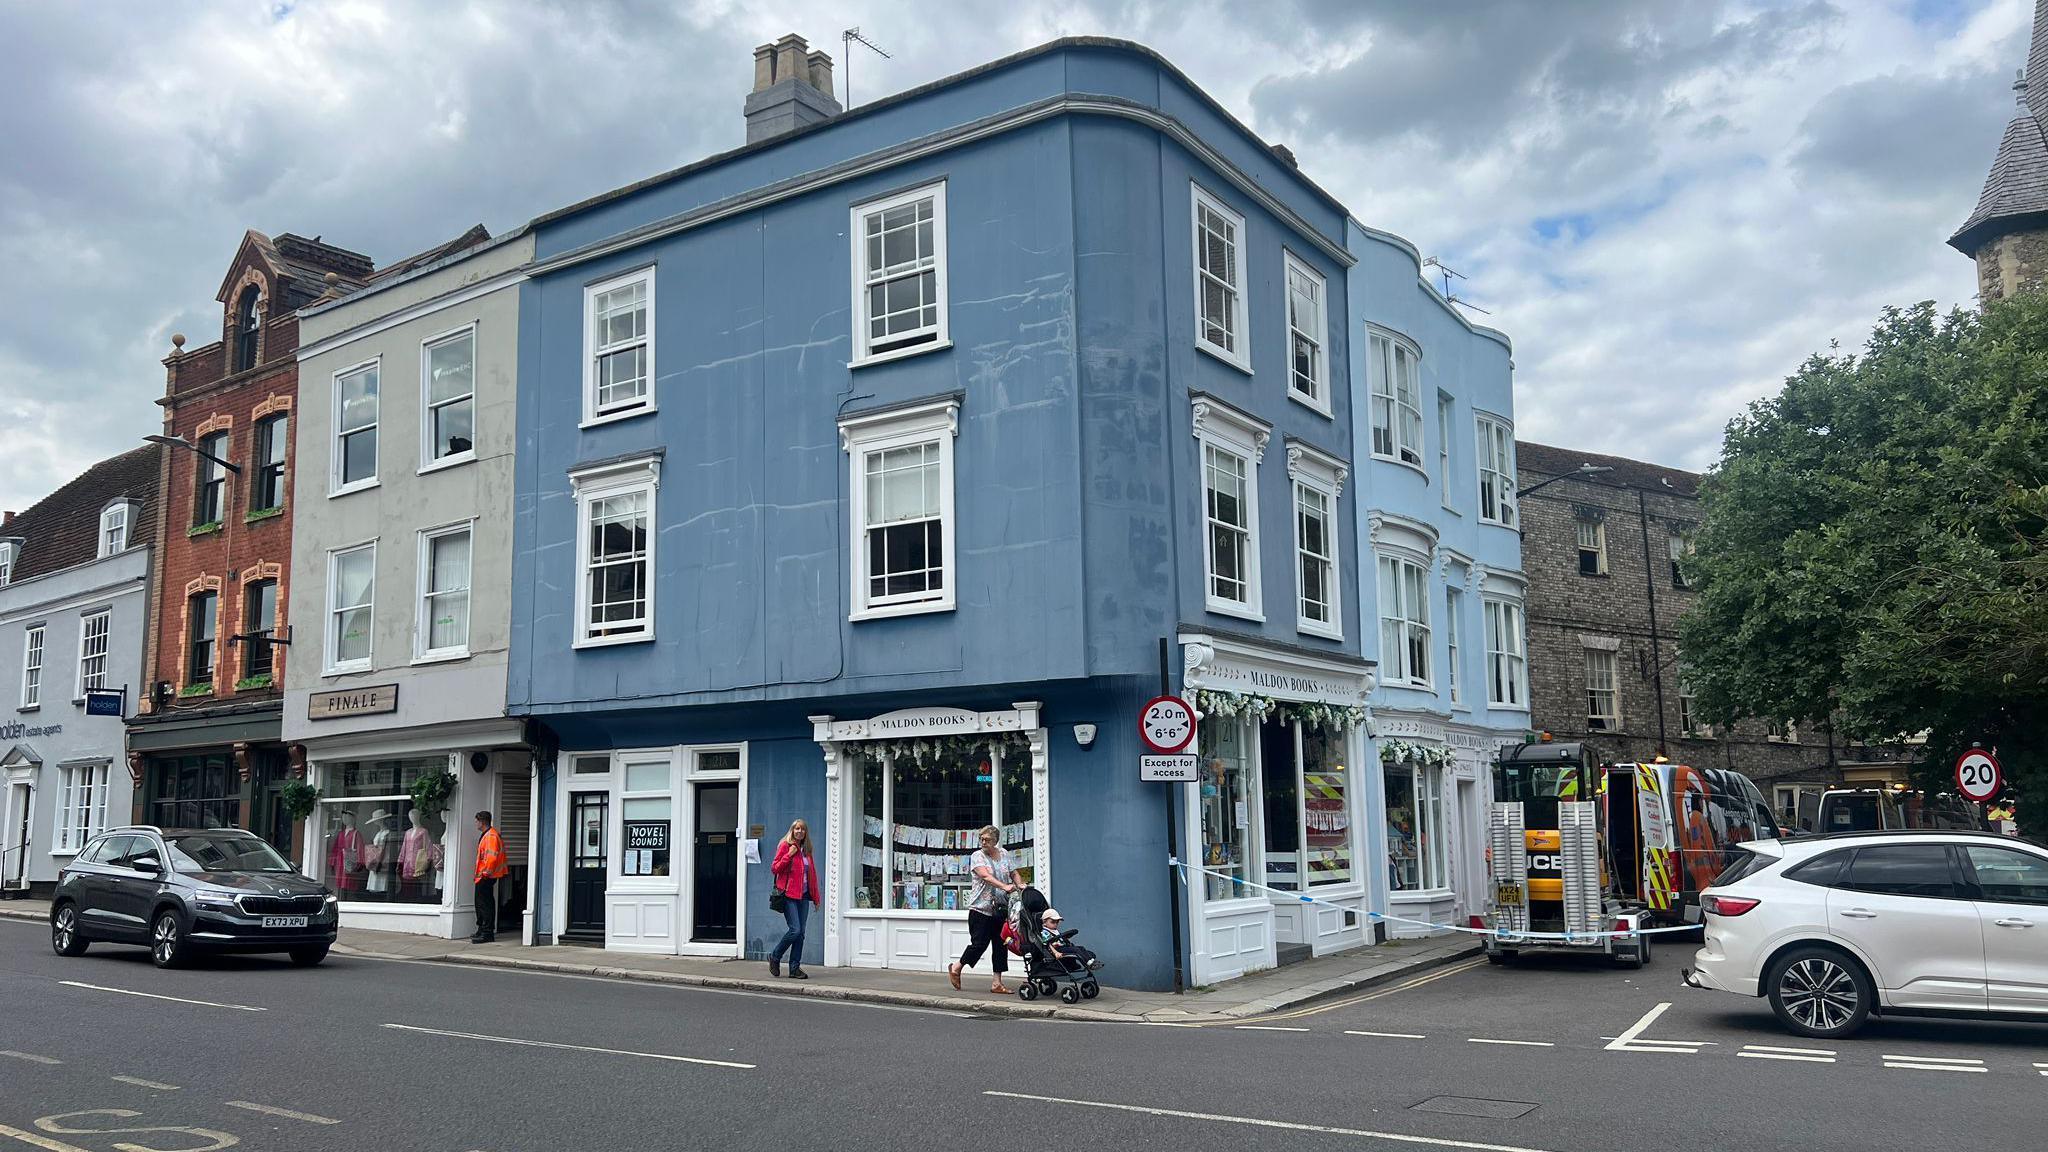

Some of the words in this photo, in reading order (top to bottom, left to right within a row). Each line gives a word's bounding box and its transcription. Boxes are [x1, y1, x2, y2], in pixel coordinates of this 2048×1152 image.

[1250, 671, 1289, 690] MALDON
[1291, 677, 1318, 694] BOOKS
[90, 700, 118, 709] holden
[328, 693, 377, 711] FINALE
[881, 718, 926, 729] MALDON
[929, 715, 966, 726] BOOKS
[0, 719, 26, 740] olden
[1223, 721, 1233, 743] 21
[1445, 733, 1468, 747] MALDON
[1468, 735, 1485, 748] BOOKS
[1144, 758, 1177, 769] Except
[1180, 758, 1194, 767] for
[1962, 763, 1994, 786] 20
[631, 826, 664, 837] NOVEL
[630, 837, 663, 846] SOUNDS
[265, 917, 288, 926] EX73
[289, 917, 305, 926] XPU
